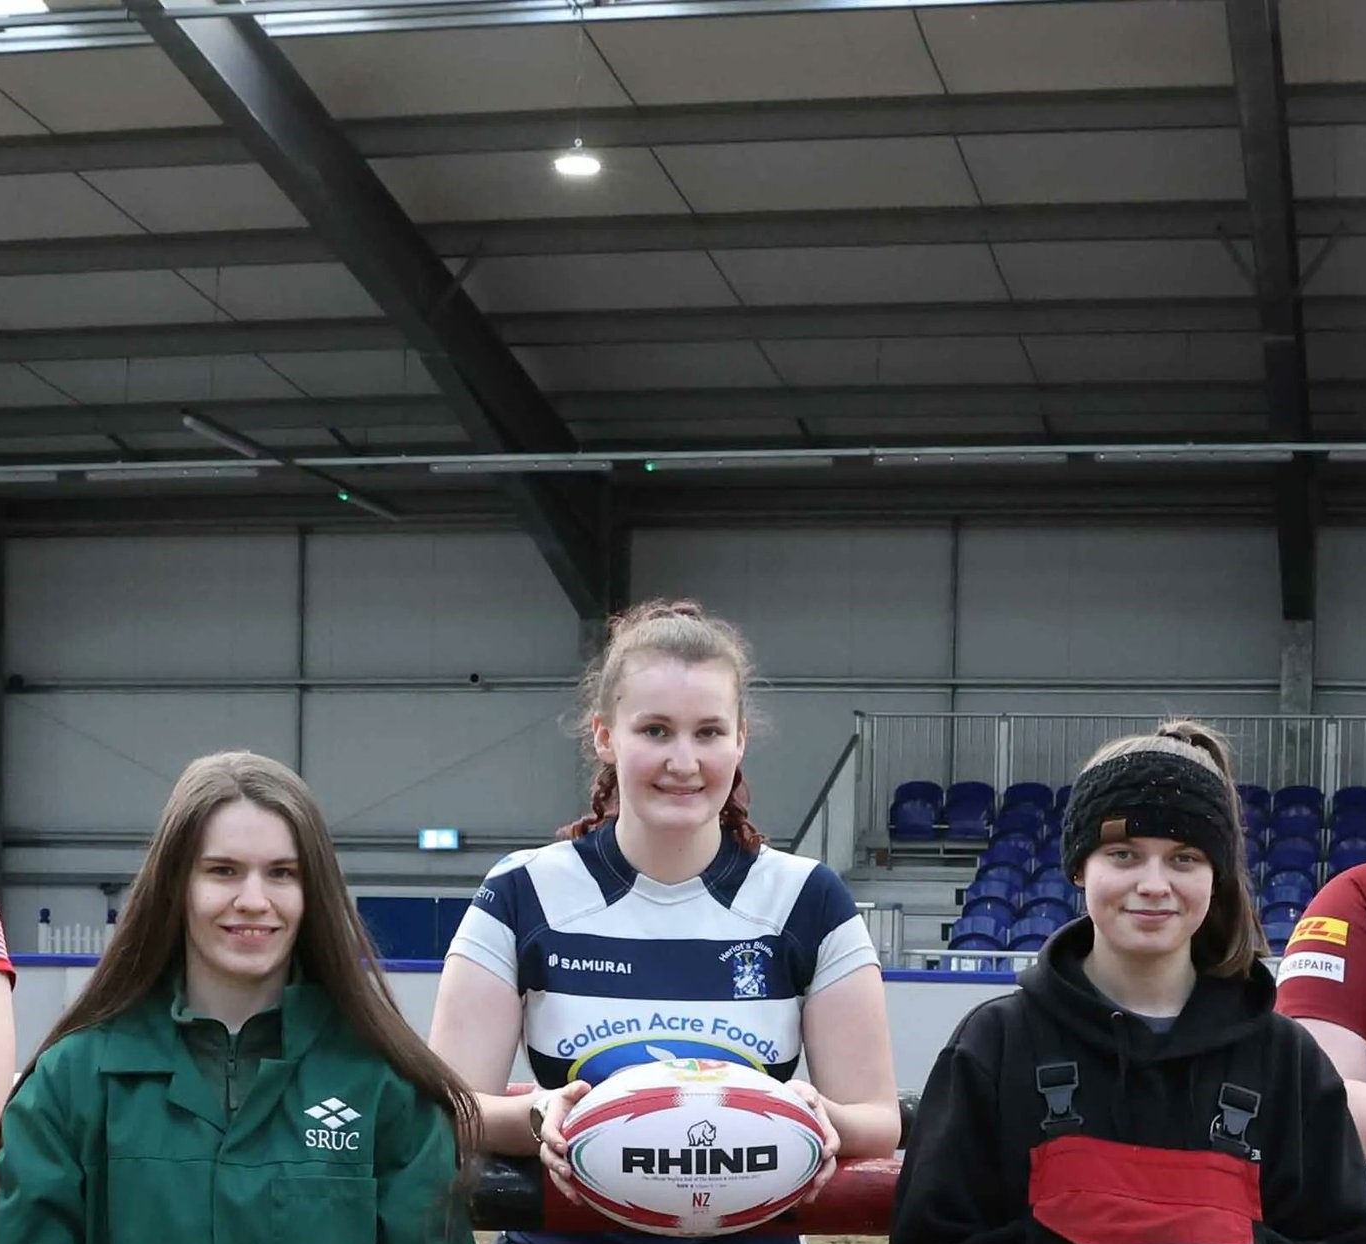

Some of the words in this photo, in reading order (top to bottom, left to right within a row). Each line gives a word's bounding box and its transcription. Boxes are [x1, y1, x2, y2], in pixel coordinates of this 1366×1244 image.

[560, 957, 632, 975] SAMURAI
[556, 1017, 642, 1058] Golden
[648, 1012, 705, 1033] Acre
[710, 1017, 780, 1064] Foods
[305, 1128, 360, 1150] SRUC
[622, 1144, 778, 1175] RHINO
[692, 1192, 711, 1207] NZ
